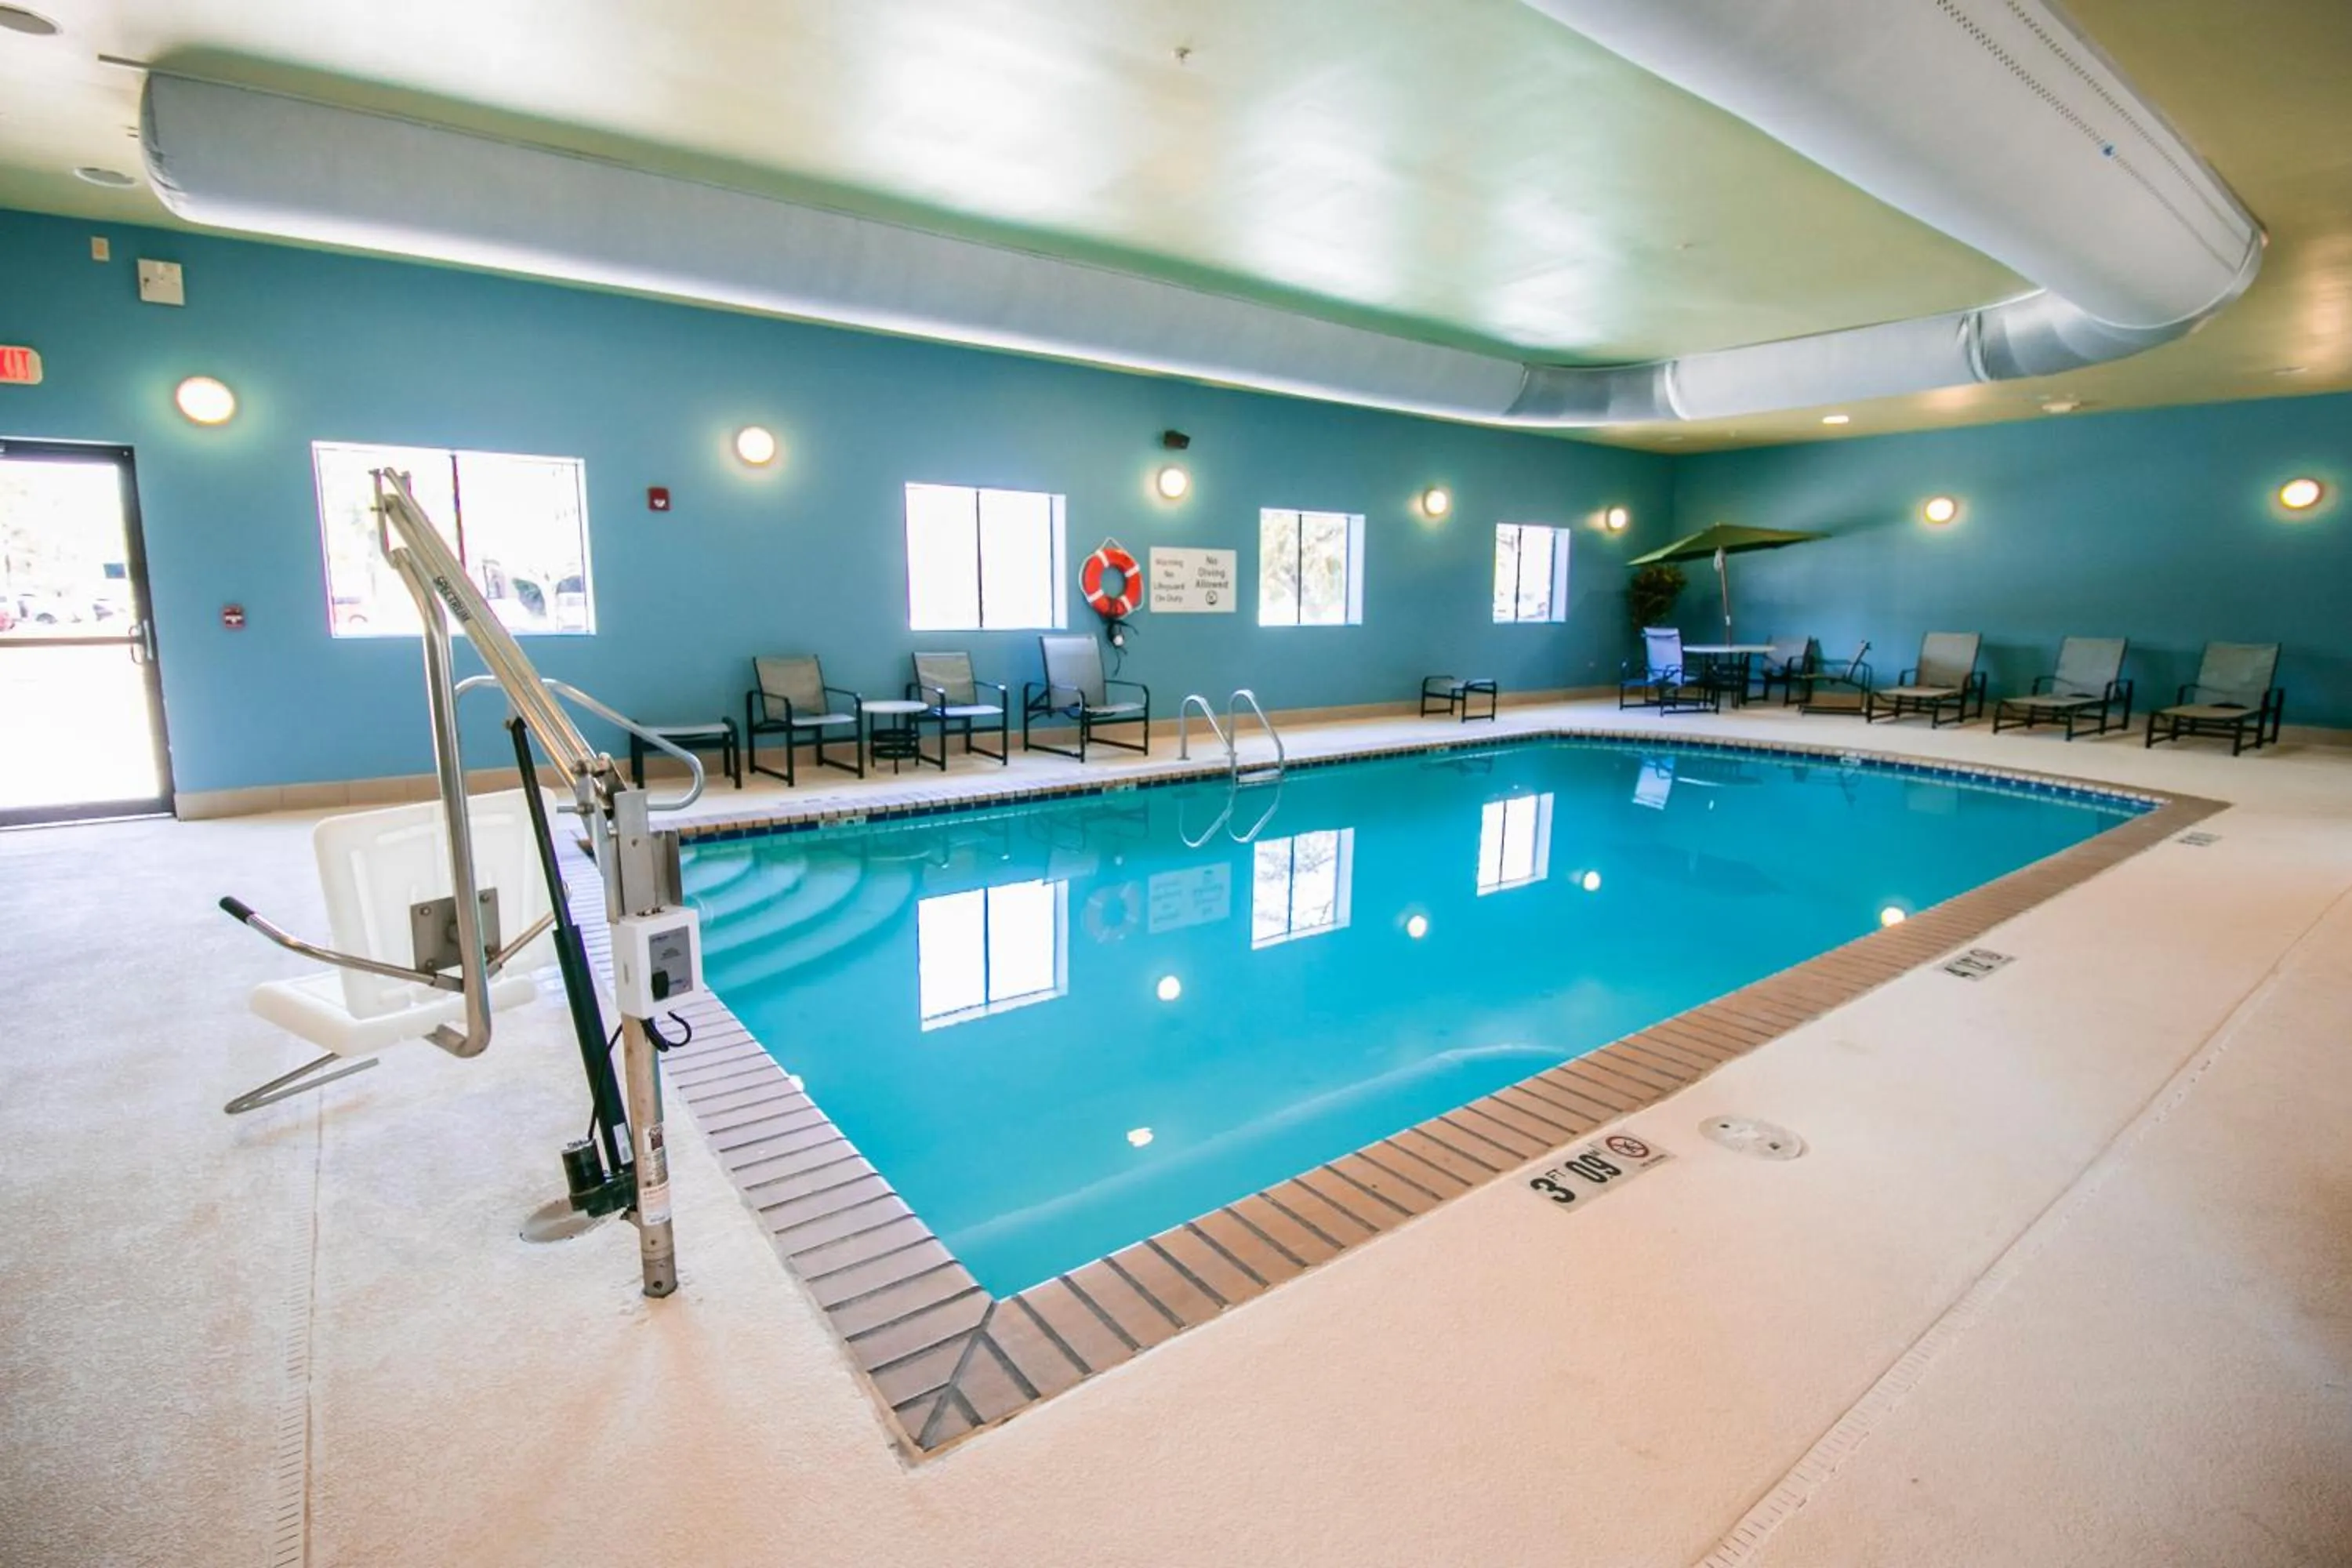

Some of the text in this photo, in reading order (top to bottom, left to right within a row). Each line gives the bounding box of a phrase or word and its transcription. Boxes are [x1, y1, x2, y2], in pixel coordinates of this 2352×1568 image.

[1155, 558, 1184, 568] Warning
[1206, 555, 1218, 565] No
[1197, 567, 1225, 579] Diving
[1154, 582, 1185, 591] Lifeguard
[1196, 579, 1229, 590] Allowed
[1167, 593, 1183, 603] Duty
[1530, 1177, 1576, 1203] 3
[1564, 1153, 1622, 1183] 09
